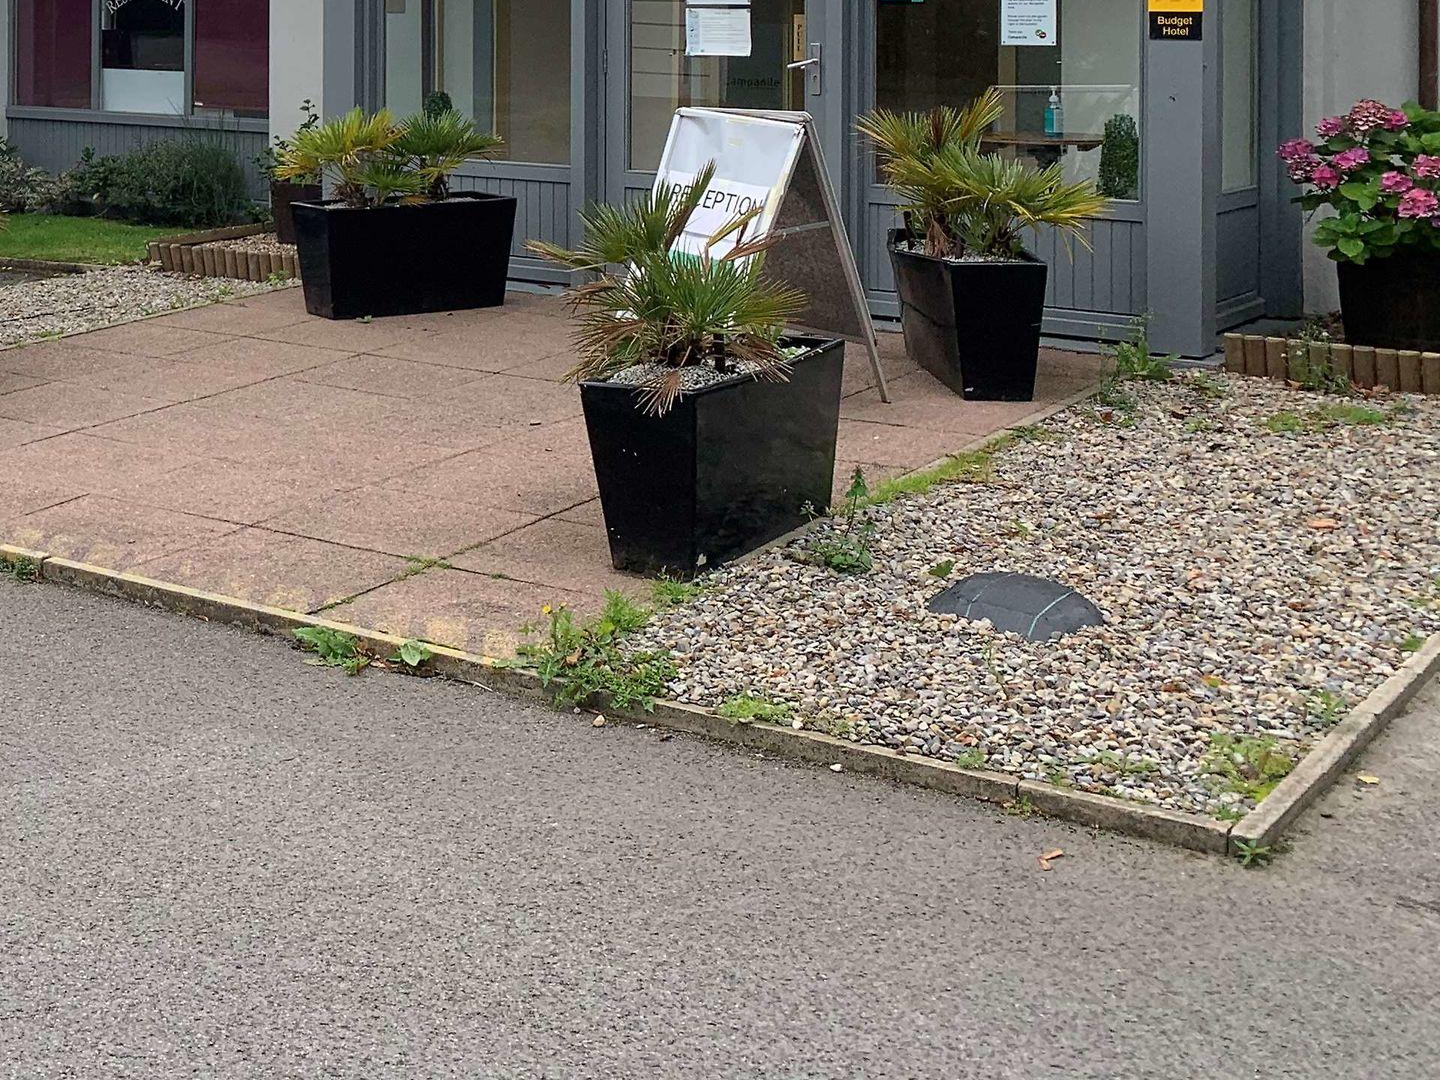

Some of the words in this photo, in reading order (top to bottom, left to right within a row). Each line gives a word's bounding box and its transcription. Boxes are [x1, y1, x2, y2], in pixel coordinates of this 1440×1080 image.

[1157, 15, 1193, 27] Budget
[1162, 26, 1189, 36] Hotel
[670, 183, 764, 215] REEPTION
